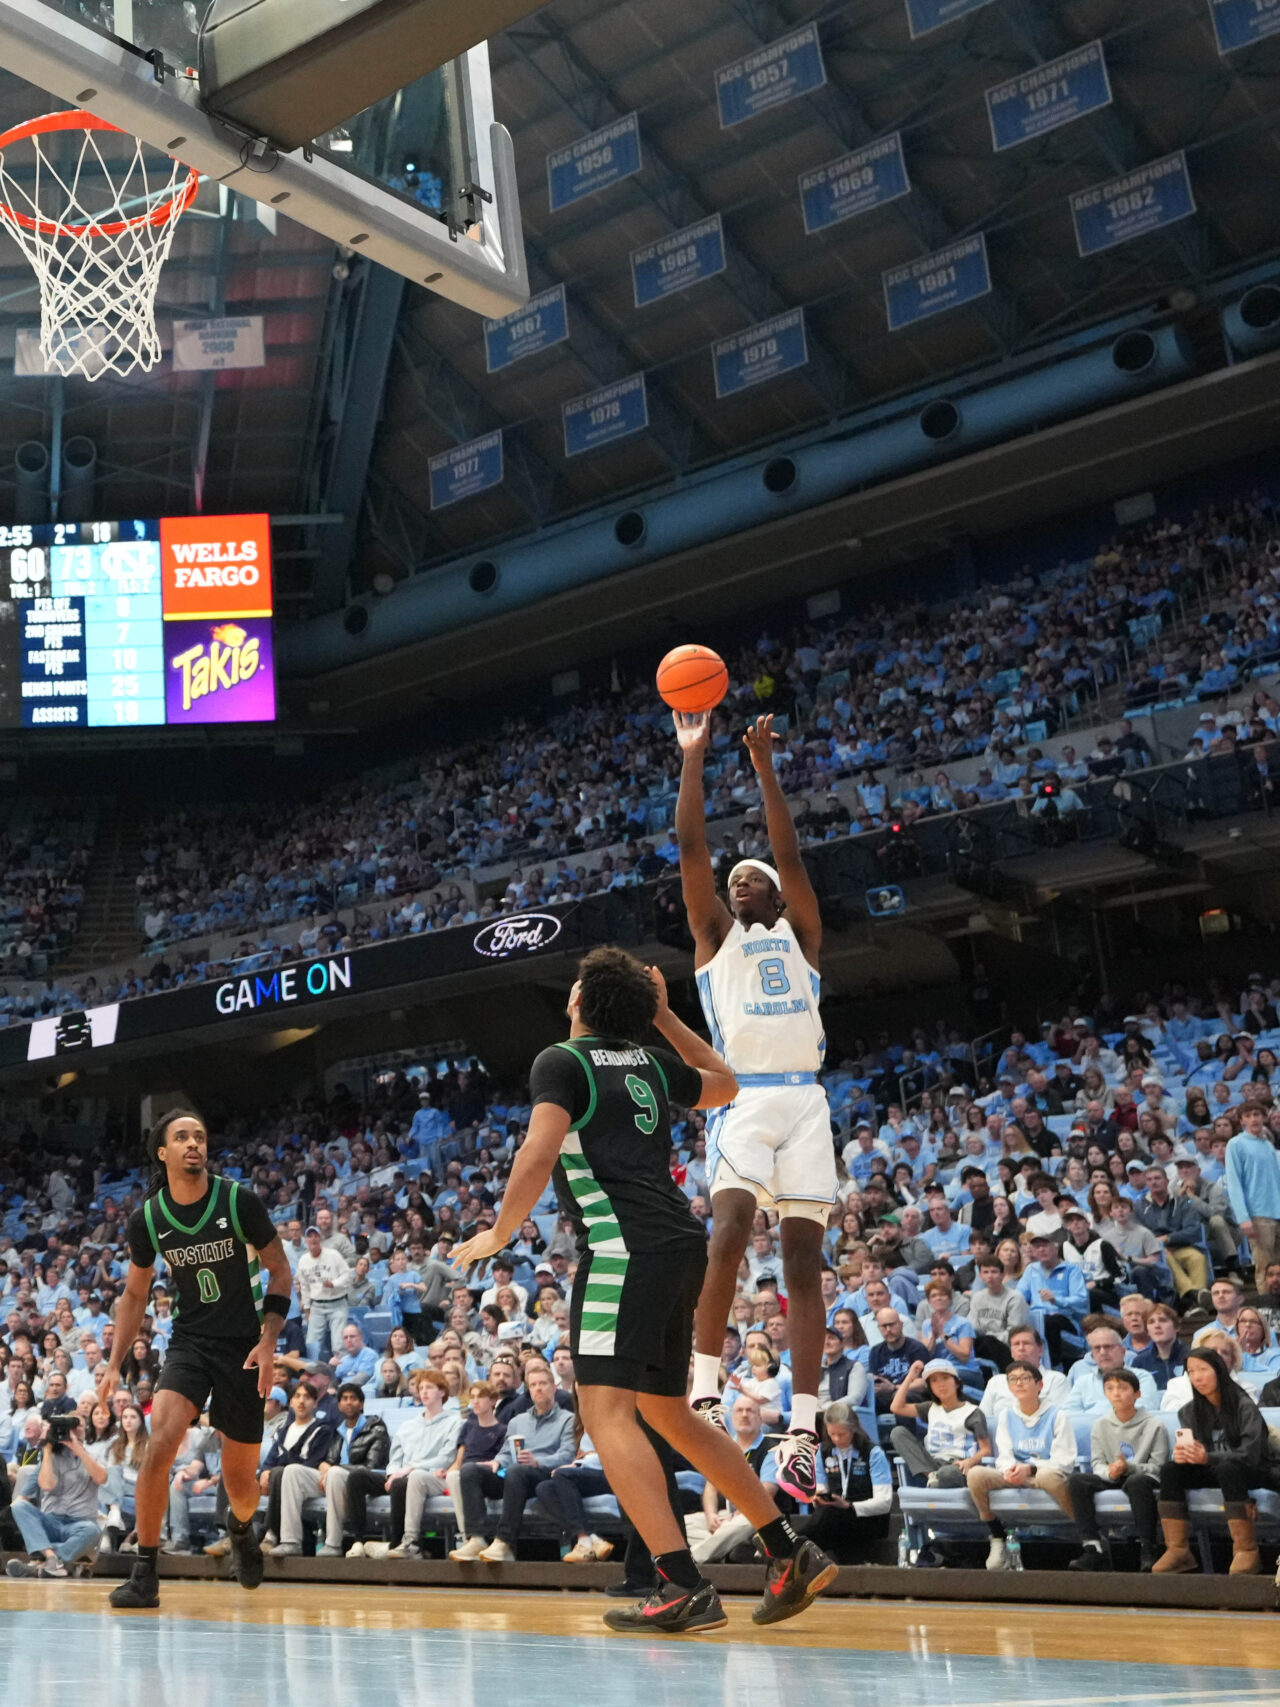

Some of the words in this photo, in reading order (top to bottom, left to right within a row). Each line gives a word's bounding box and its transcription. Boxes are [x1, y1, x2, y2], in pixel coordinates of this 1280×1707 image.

[720, 65, 742, 85] ACC
[745, 29, 813, 72] CHAMPIONS
[1020, 50, 1099, 90] CHAMPIONS
[750, 59, 788, 90] 1957
[551, 150, 571, 168] ACC
[573, 119, 634, 157] CHAMPIONS
[802, 171, 825, 190] ACC
[828, 139, 897, 178] CHAMPIONS
[832, 167, 874, 198] 1969
[1075, 191, 1100, 210] ACC
[1103, 158, 1181, 198] CHAMPIONS
[1108, 186, 1154, 219] 1982
[635, 248, 655, 265] ACC
[657, 219, 718, 255] CHAMPIONS
[888, 269, 910, 286] ACC
[912, 239, 980, 277] CHAMPIONS
[917, 266, 955, 294] 1981
[716, 340, 737, 356] ACC
[738, 312, 799, 348] CHAMPIONS
[743, 338, 777, 365] 1979
[565, 403, 584, 417] ACC
[585, 378, 640, 408] CHAMPIONS
[449, 435, 499, 464] CHAMPIONS
[453, 457, 479, 480] 1977
[10, 547, 45, 582] 60
[59, 546, 92, 580] 73
[172, 541, 259, 564] WELLS
[174, 564, 260, 588] FARGO
[44, 635, 62, 648] PTS
[116, 623, 130, 644] 7
[45, 661, 63, 674] PTS
[113, 649, 137, 670] 10
[172, 636, 260, 710] Takis
[22, 682, 52, 696] BENCH
[54, 681, 87, 695] POINTS
[33, 707, 78, 722] ASSISTS
[490, 918, 544, 950] Ford
[741, 938, 790, 957] NORTH
[215, 969, 297, 1014] GAME
[306, 957, 352, 994] ON
[758, 958, 790, 995] 8
[625, 1074, 658, 1135] 9
[164, 1238, 235, 1267] UPSTATE
[196, 1268, 221, 1303] 0
